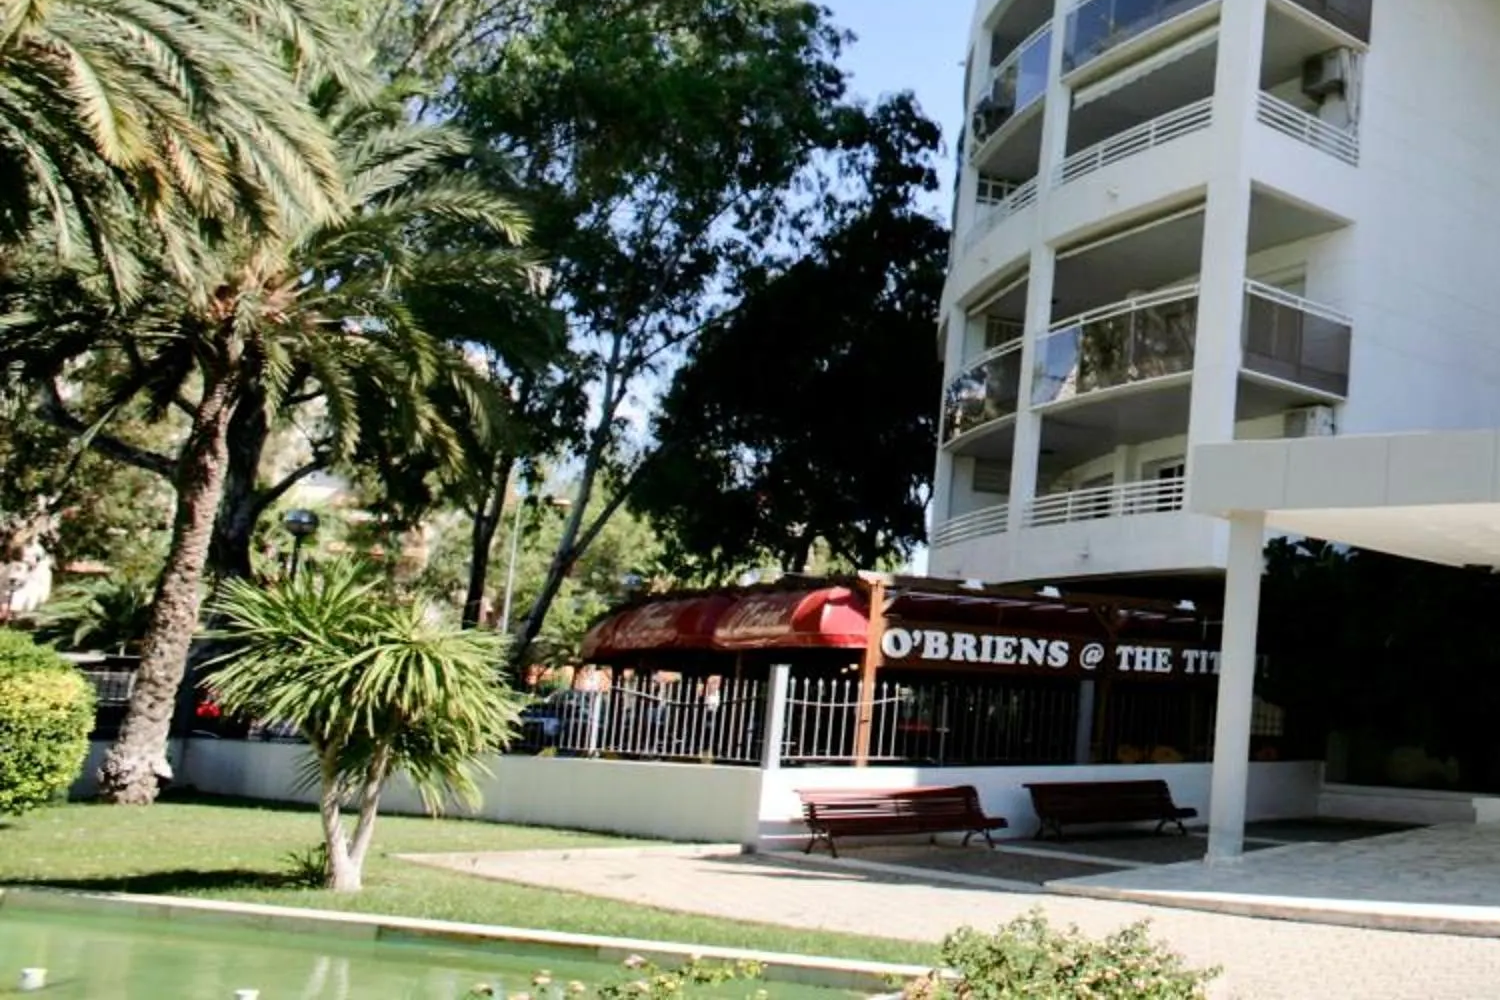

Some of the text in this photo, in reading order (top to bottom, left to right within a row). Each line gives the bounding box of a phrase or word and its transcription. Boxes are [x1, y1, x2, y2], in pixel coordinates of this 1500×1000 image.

[882, 628, 1223, 675] O'BRIENS @ THE TIT
